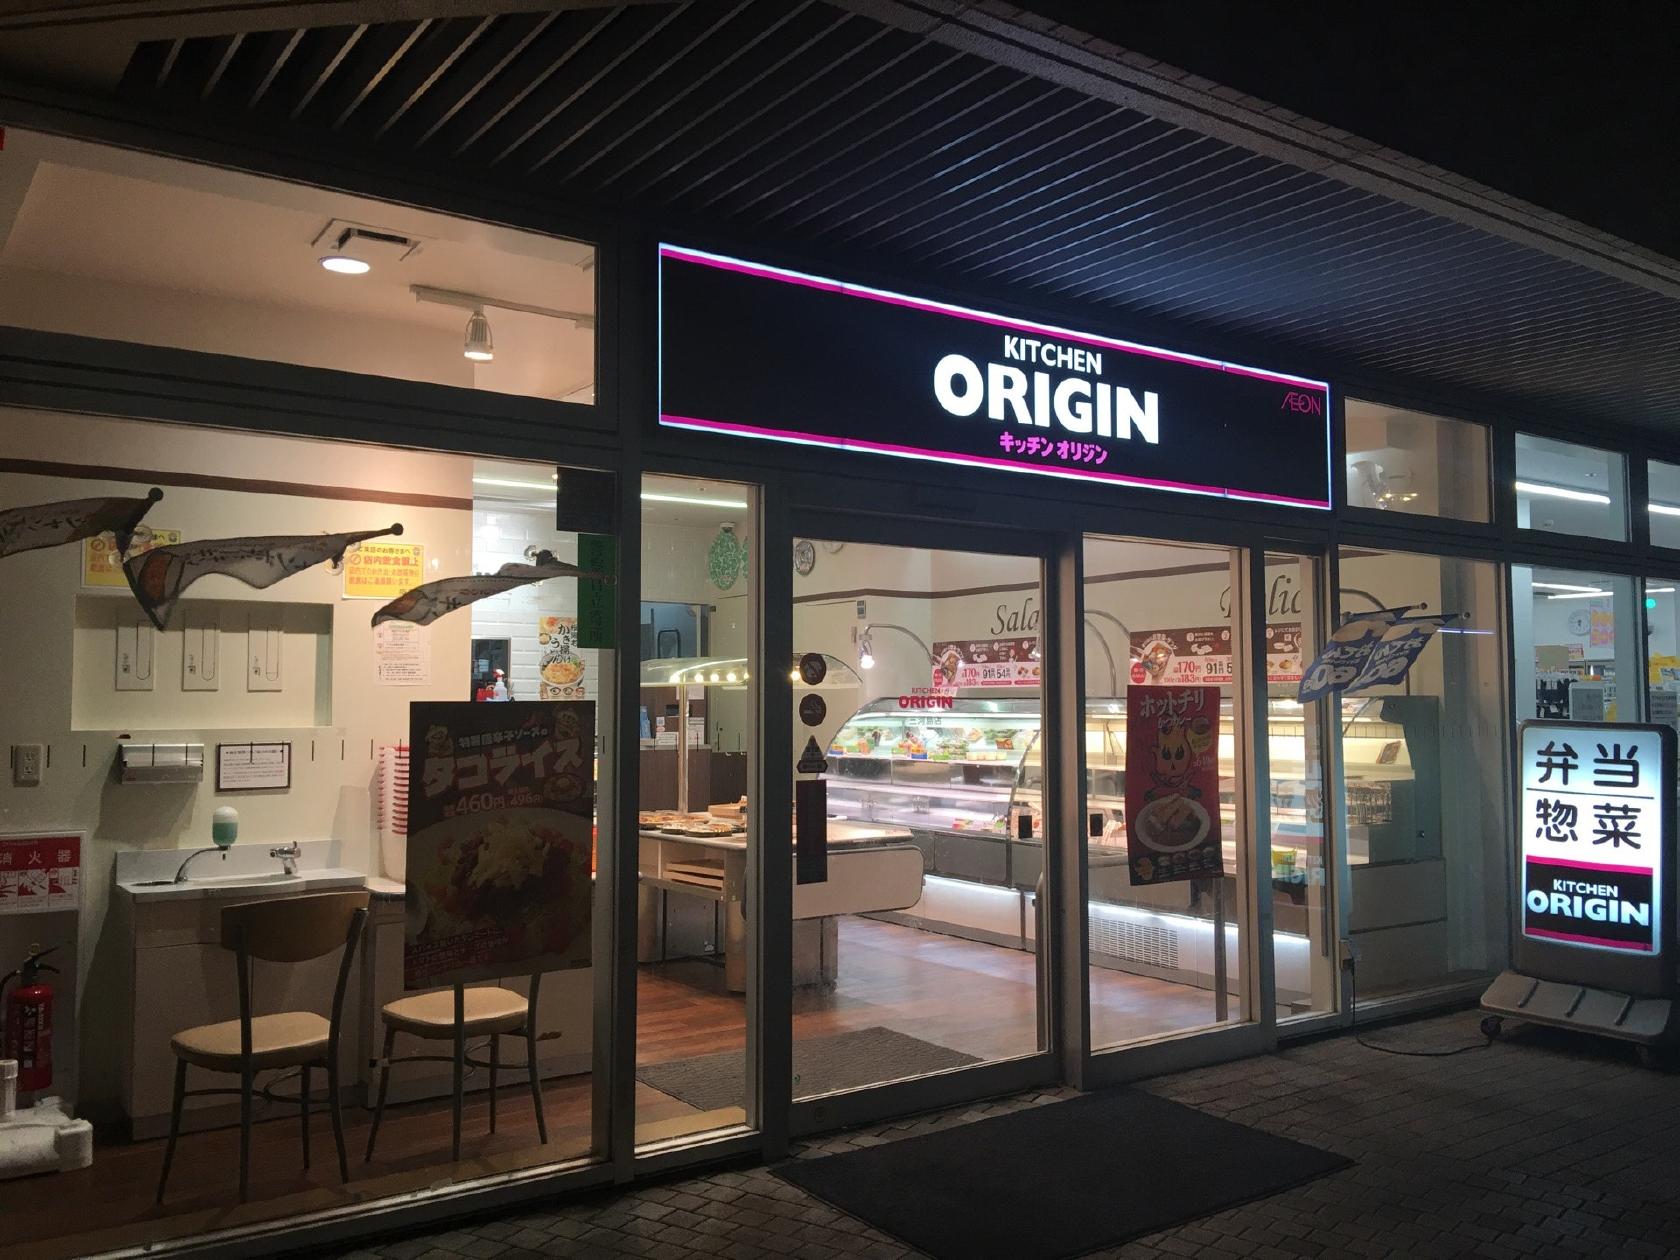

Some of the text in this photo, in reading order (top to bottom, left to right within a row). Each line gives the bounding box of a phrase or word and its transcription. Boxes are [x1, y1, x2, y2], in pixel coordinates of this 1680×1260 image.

[1003, 335, 1103, 376] KITCHEN
[933, 353, 1160, 445] ORIGIN
[898, 695, 953, 709] ORIGIN
[422, 737, 585, 798] タコライス
[1535, 741, 1642, 789] 弁当
[1535, 798, 1643, 850] 惣菜
[1526, 889, 1651, 928] ORIGIN
[1553, 879, 1618, 898] KITCHEN
